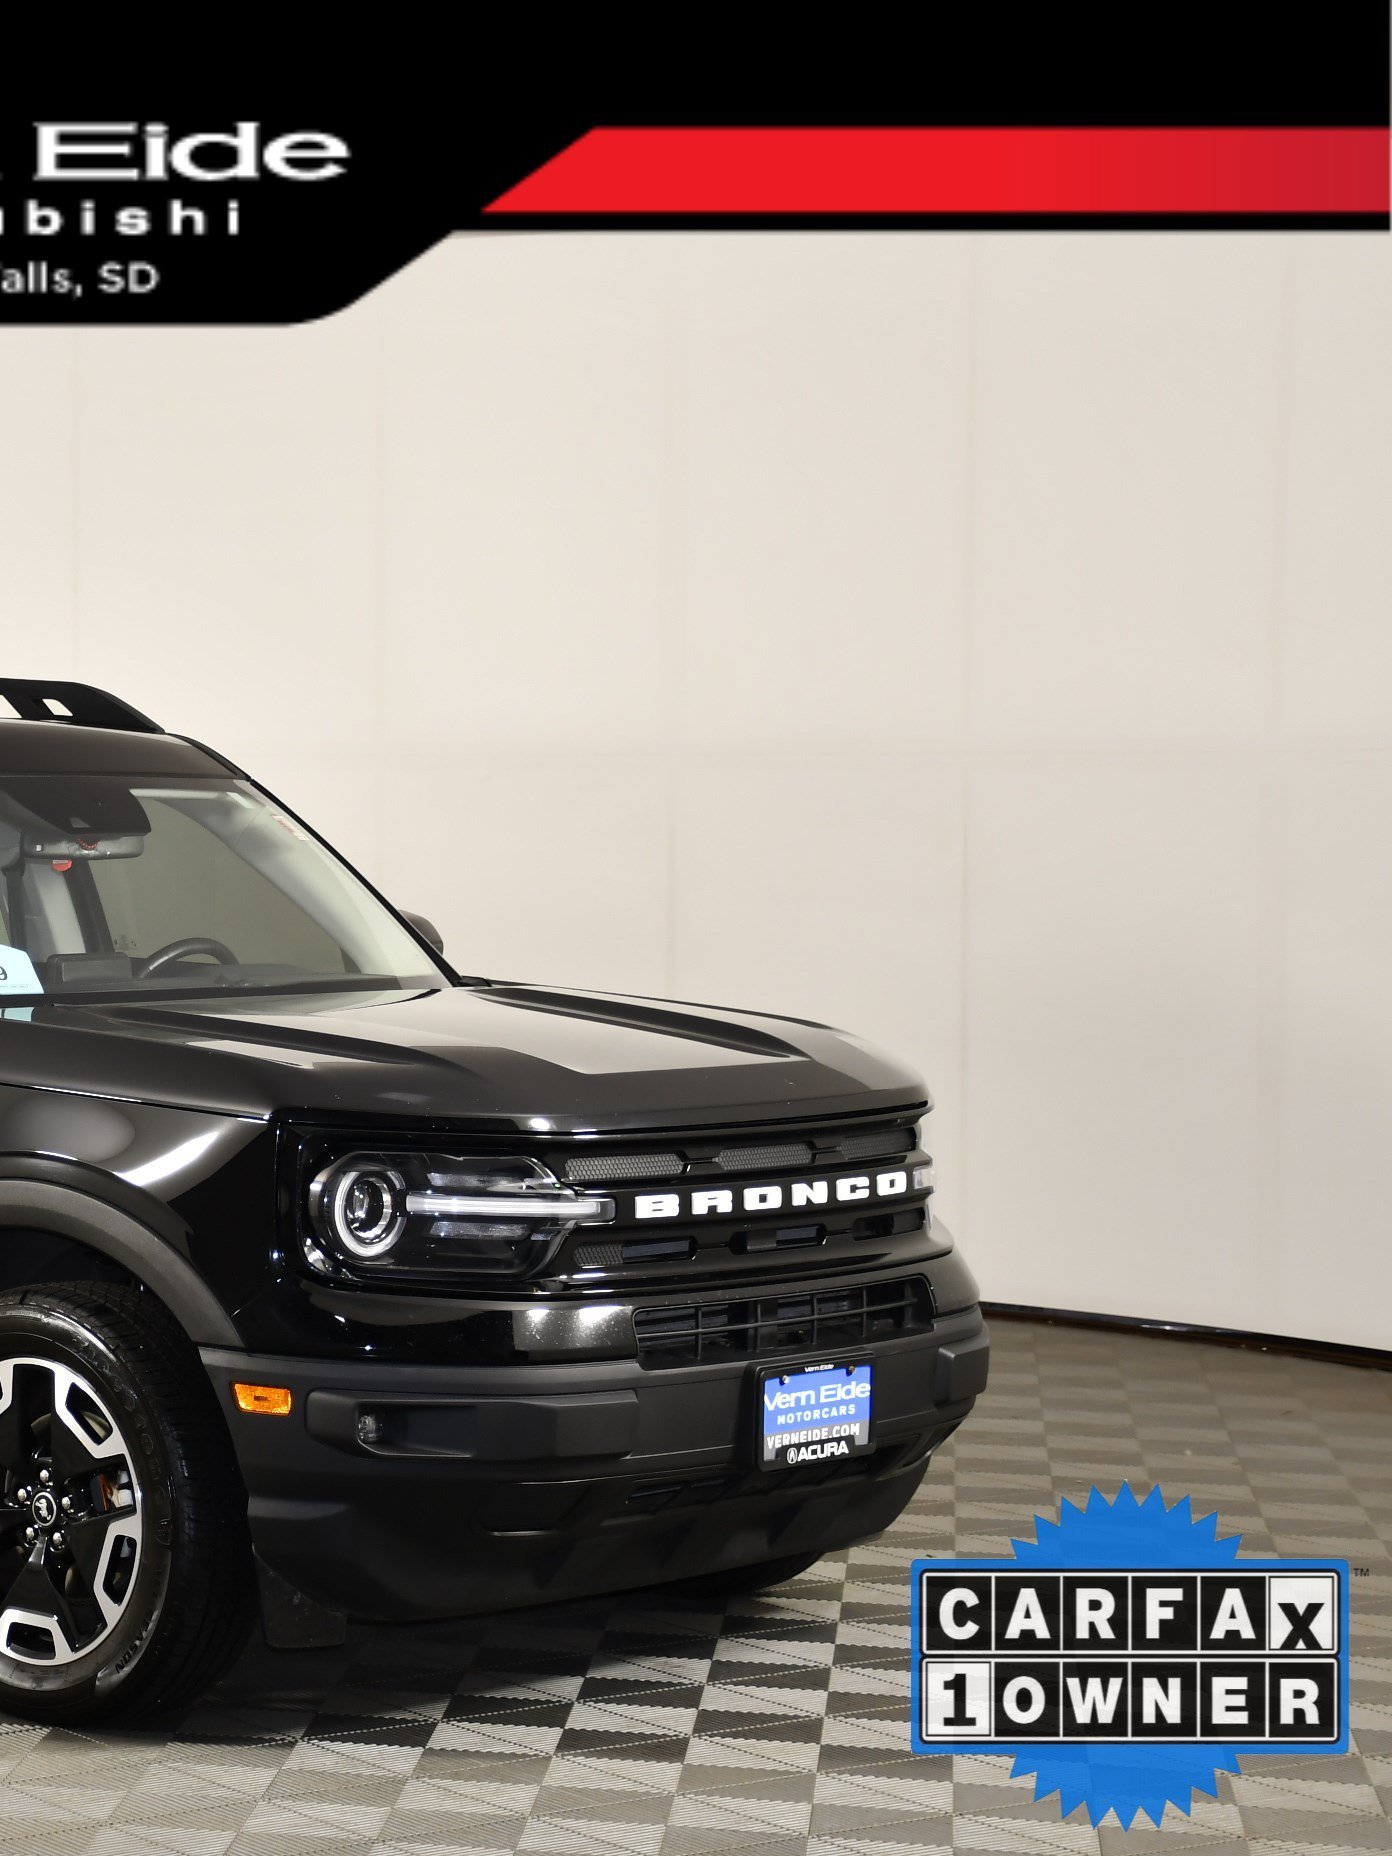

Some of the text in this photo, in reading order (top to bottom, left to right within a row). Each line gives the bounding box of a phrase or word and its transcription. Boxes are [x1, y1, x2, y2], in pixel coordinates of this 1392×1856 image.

[634, 1170, 908, 1219] BRONCO
[764, 1381, 871, 1411] Vern Eide
[777, 1404, 856, 1425] MOTORCARS
[766, 1423, 860, 1450] VERNEIDE.COM
[797, 1441, 850, 1462] ACURA
